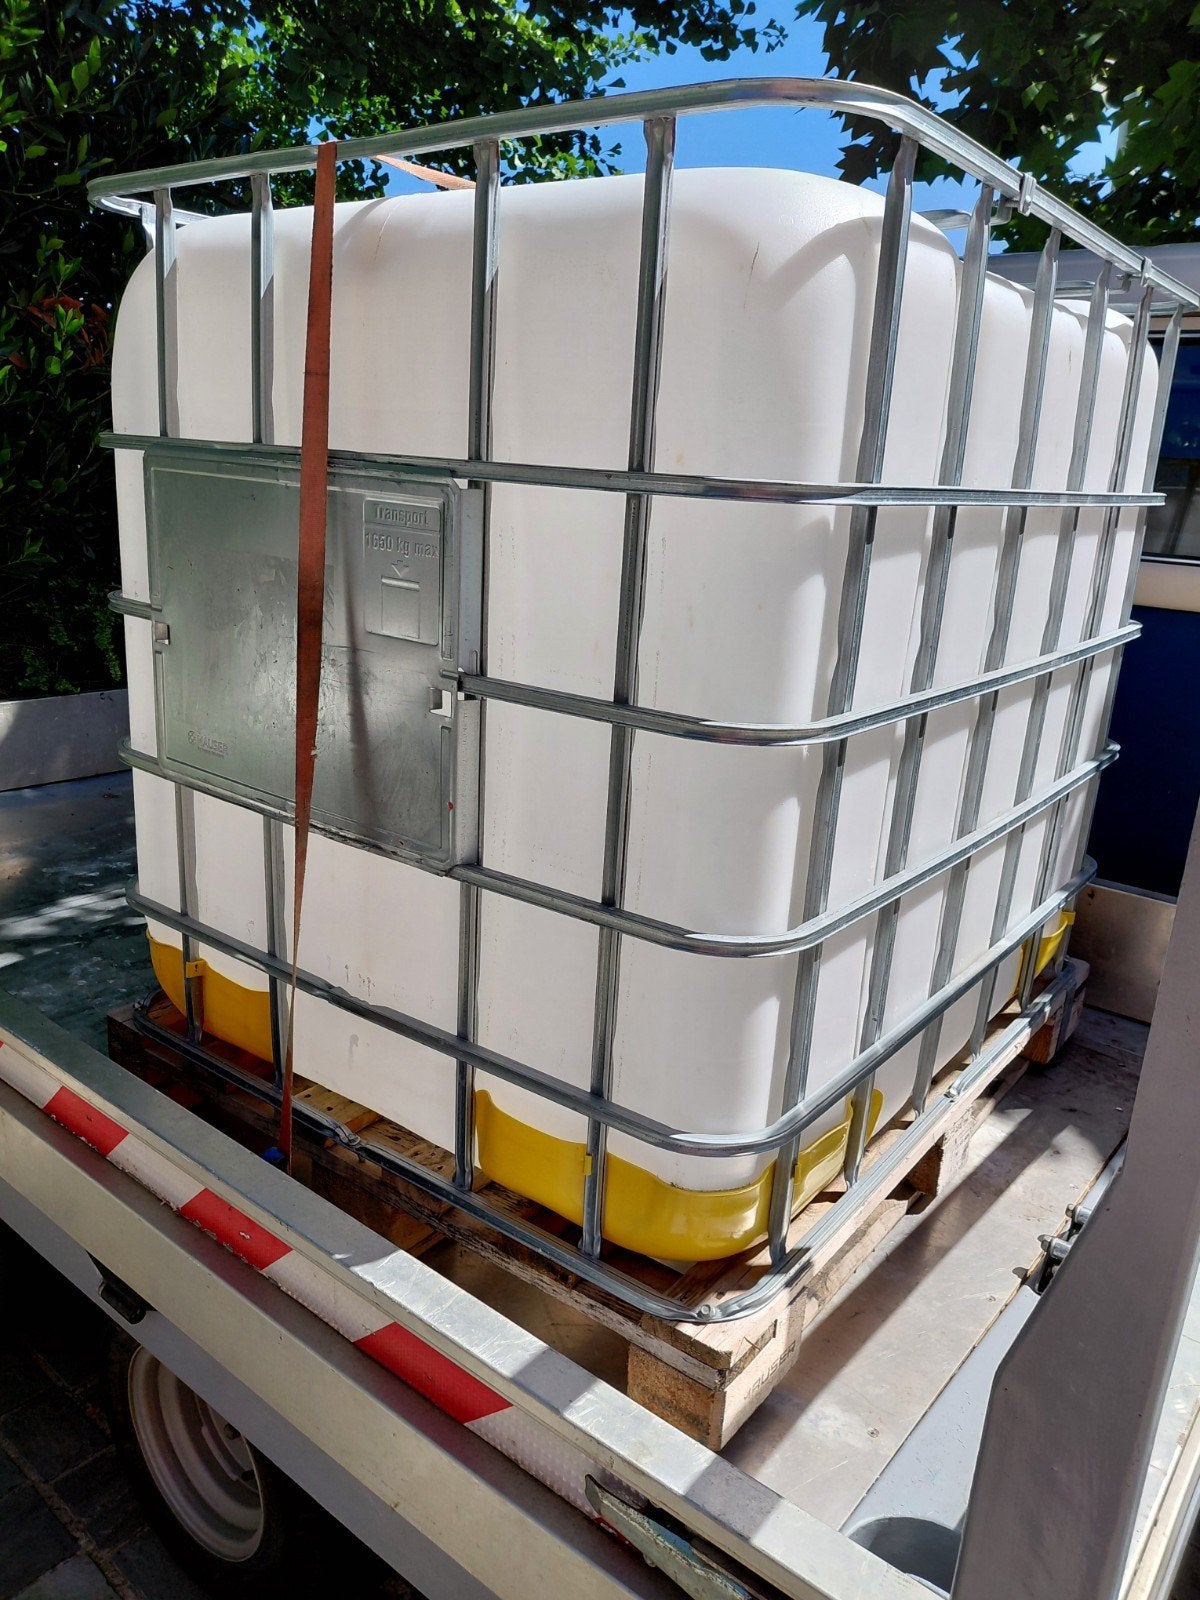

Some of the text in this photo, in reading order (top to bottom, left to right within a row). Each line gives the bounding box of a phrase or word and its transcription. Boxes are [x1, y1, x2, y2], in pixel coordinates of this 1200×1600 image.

[374, 503, 429, 527] Transport
[365, 532, 440, 558] 1650 kg max
